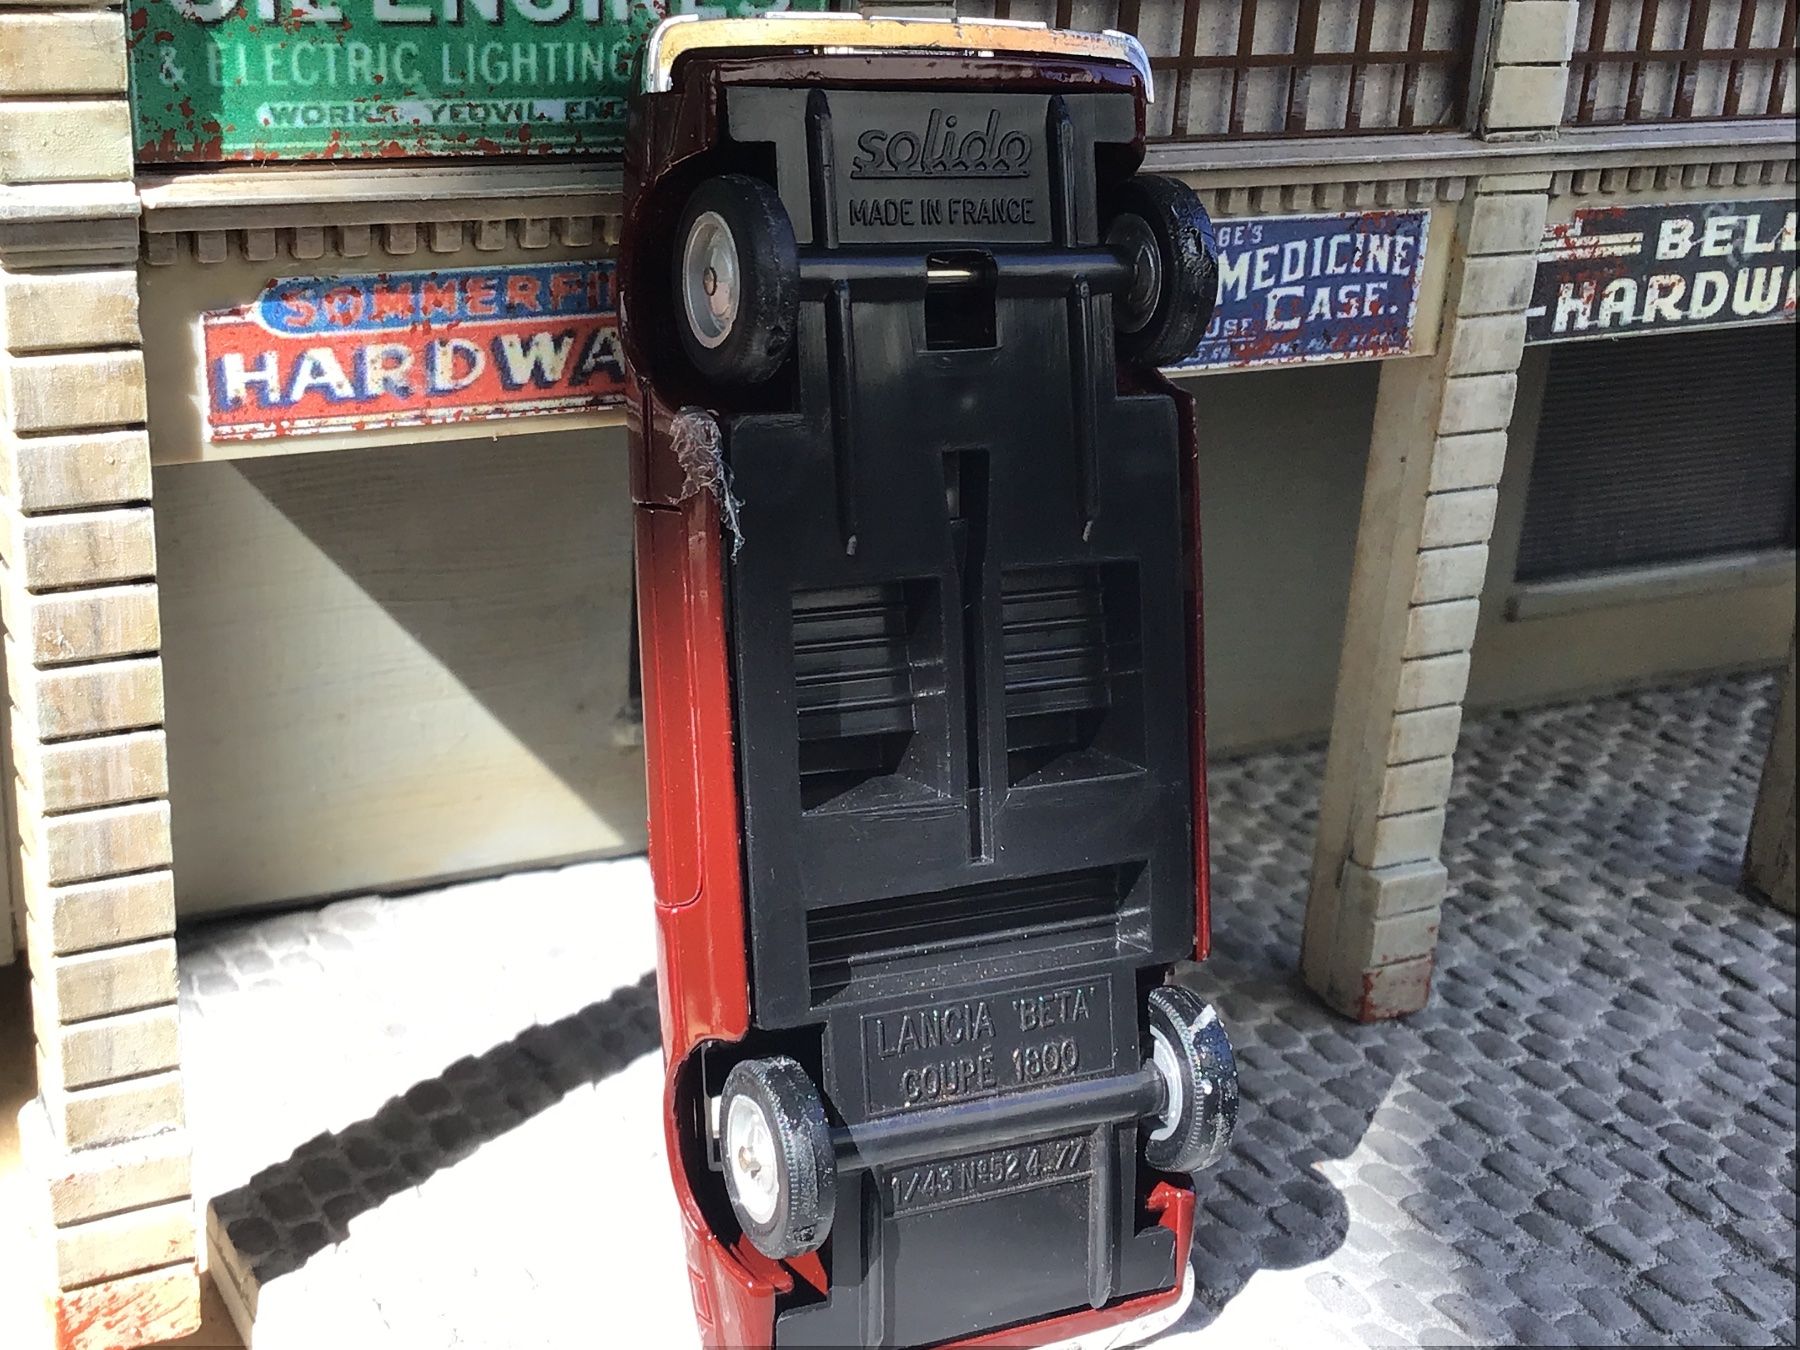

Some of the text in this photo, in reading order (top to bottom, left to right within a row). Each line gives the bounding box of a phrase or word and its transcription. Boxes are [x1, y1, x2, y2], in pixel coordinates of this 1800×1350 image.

[159, 41, 634, 86] & ELECTRIC LIGHTING
[852, 108, 1032, 174] solido
[849, 198, 1036, 226] MADE IN FRANCE
[1214, 232, 1415, 307] MEDICINE
[876, 1000, 997, 1060] LANCIA
[903, 1036, 1080, 1100] COUPÉ 1800
[891, 1165, 953, 1206] 1/43
